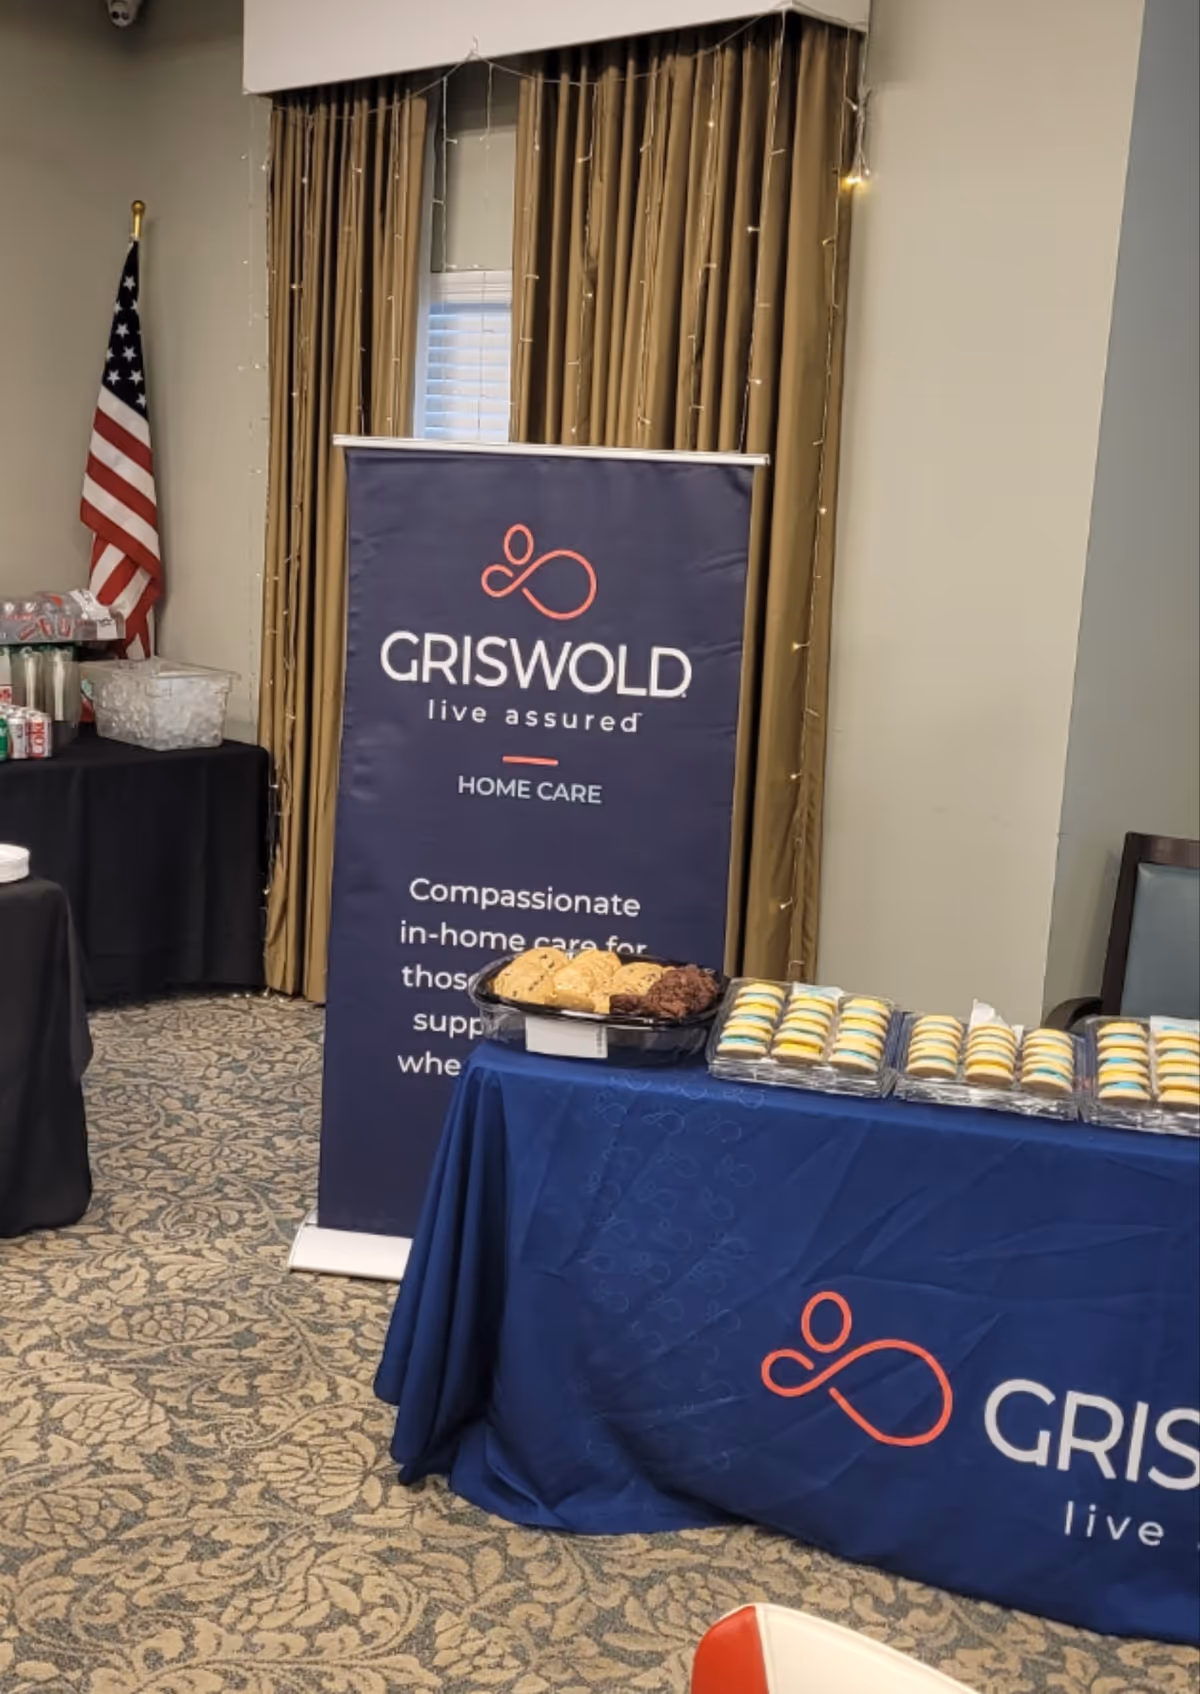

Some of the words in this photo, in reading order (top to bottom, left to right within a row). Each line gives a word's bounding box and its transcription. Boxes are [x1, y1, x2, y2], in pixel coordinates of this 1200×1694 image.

[380, 630, 692, 698] GRISWOLD
[428, 698, 487, 723] live
[505, 708, 642, 733] assured
[458, 775, 532, 799] HOME
[536, 781, 603, 804] CARE
[409, 878, 641, 917] Compassionate
[399, 920, 526, 952] in-home
[401, 963, 476, 991] thos
[412, 1013, 484, 1040] supp
[397, 1050, 462, 1077] whe
[1064, 1500, 1165, 1546] live
